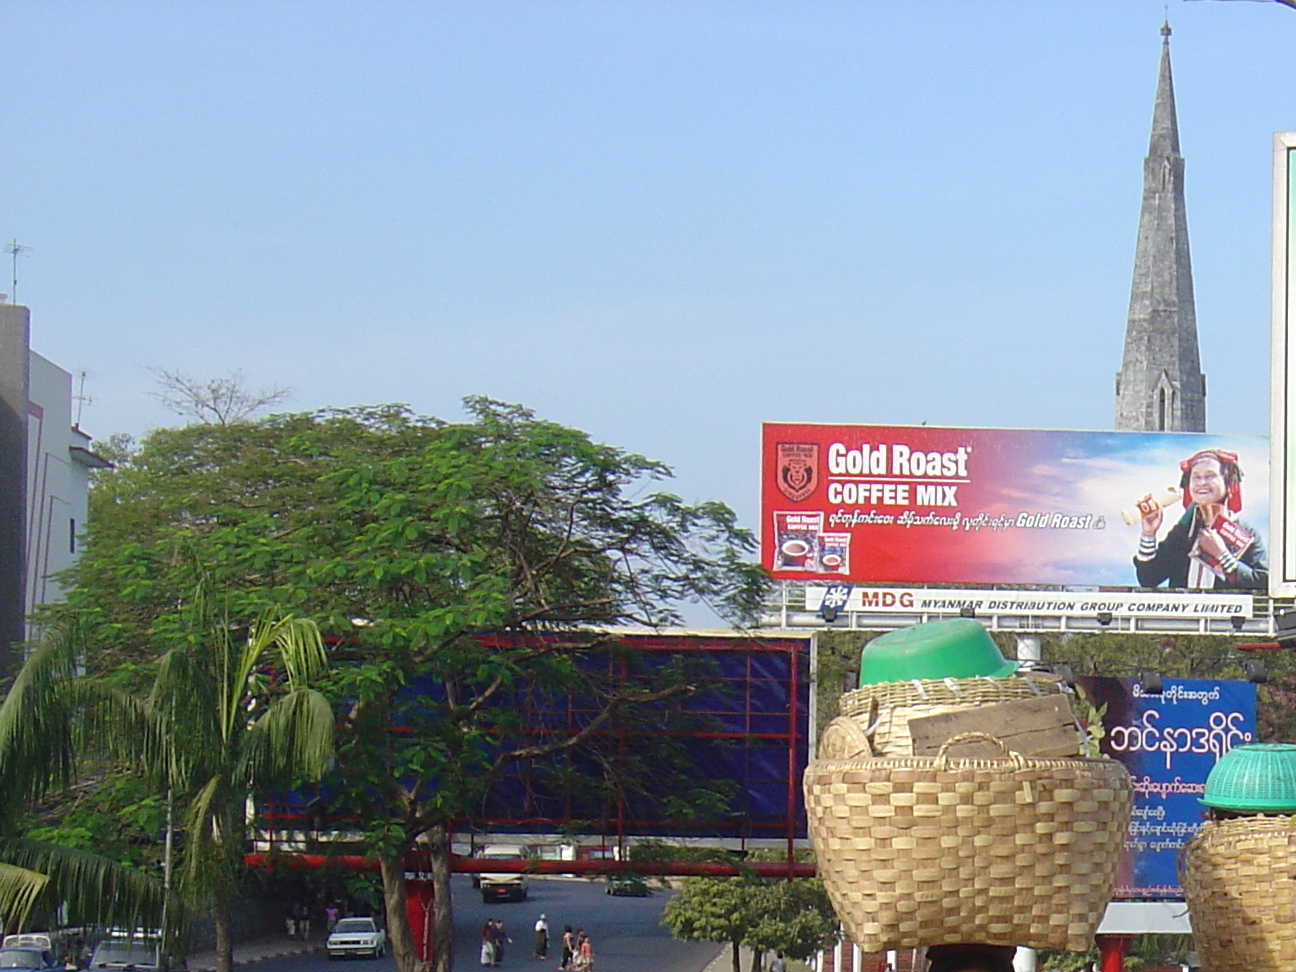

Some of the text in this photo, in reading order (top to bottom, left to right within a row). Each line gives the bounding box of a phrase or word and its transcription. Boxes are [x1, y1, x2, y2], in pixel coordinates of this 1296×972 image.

[828, 442, 969, 477] Gold Roast
[828, 482, 958, 507] COFFEE MIX
[1016, 512, 1050, 528] Gold
[1050, 512, 1093, 530] Roast
[861, 590, 1243, 614] MDG MYANMAR DISTRIBUTION GROUP COMPANY LIMITED
